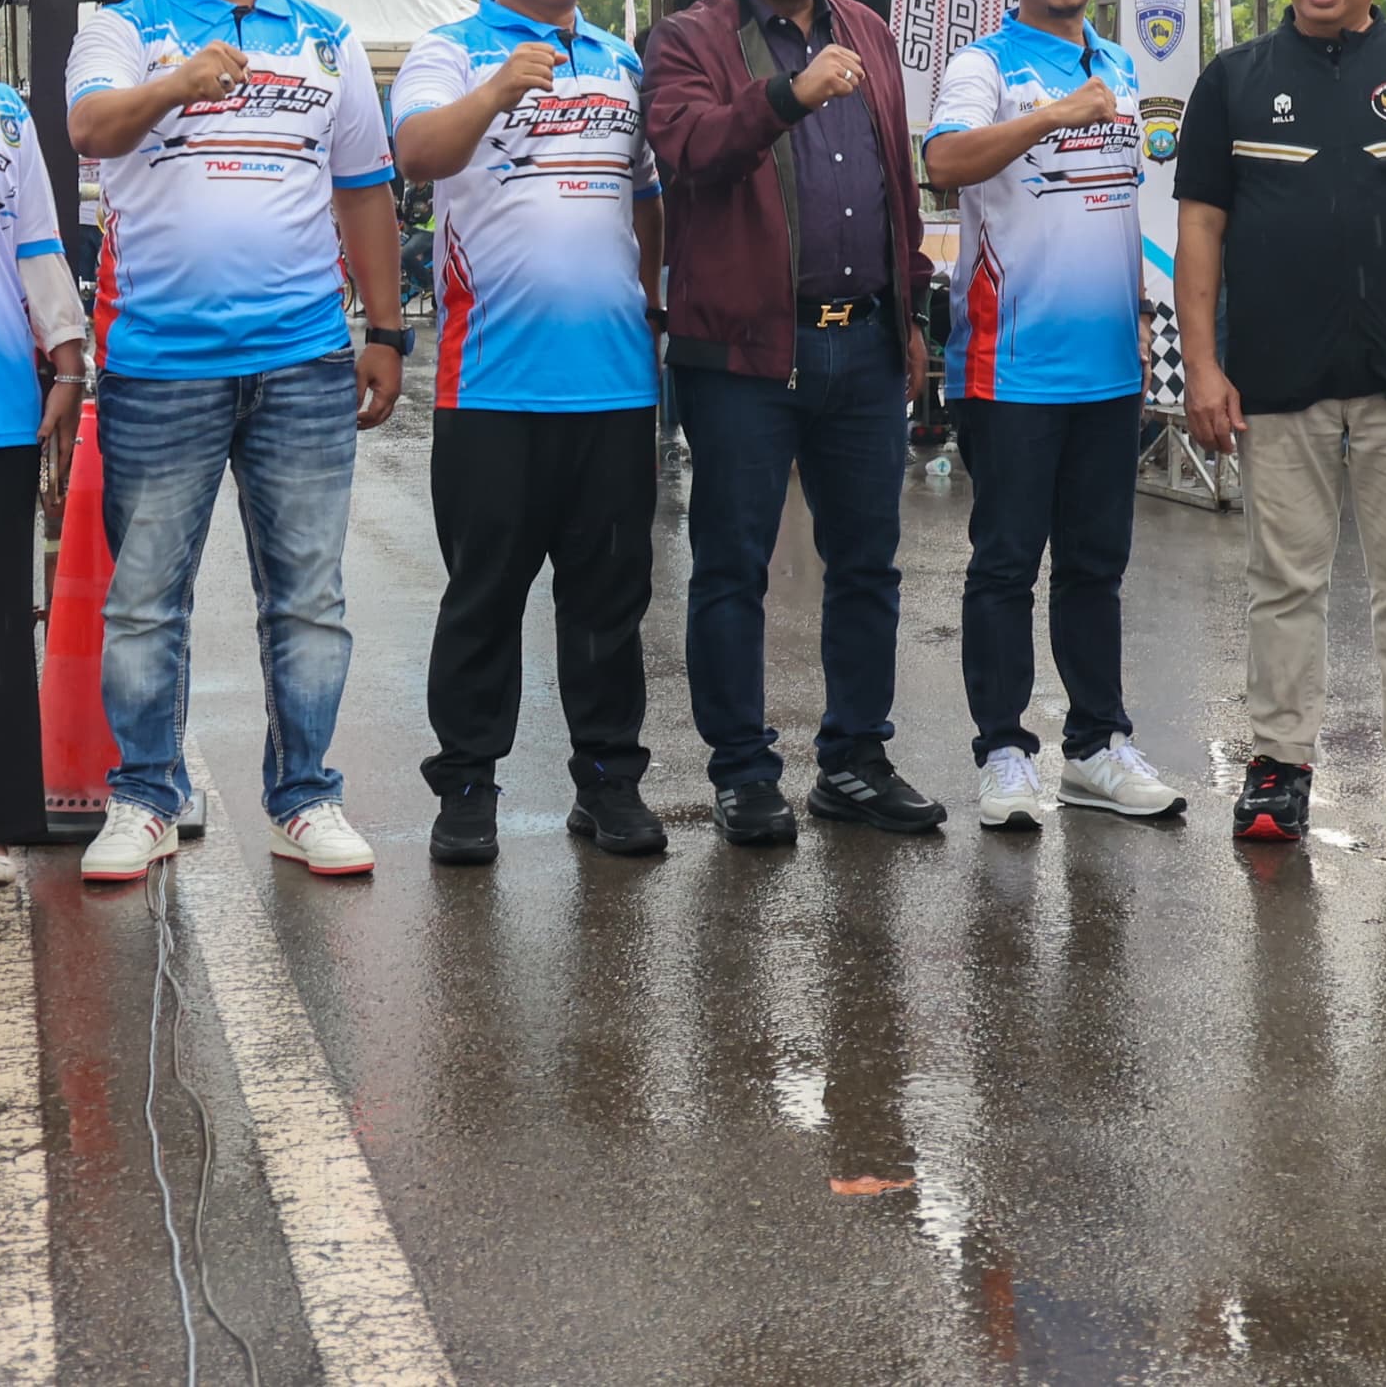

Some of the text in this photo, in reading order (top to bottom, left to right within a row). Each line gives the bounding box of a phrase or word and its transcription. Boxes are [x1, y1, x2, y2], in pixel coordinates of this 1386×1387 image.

[247, 84, 329, 104] KETUA
[245, 98, 310, 112] KEPRI
[510, 106, 579, 127] PIALA
[1272, 115, 1295, 124] MILLS
[536, 119, 634, 133] DPRD KEPRI
